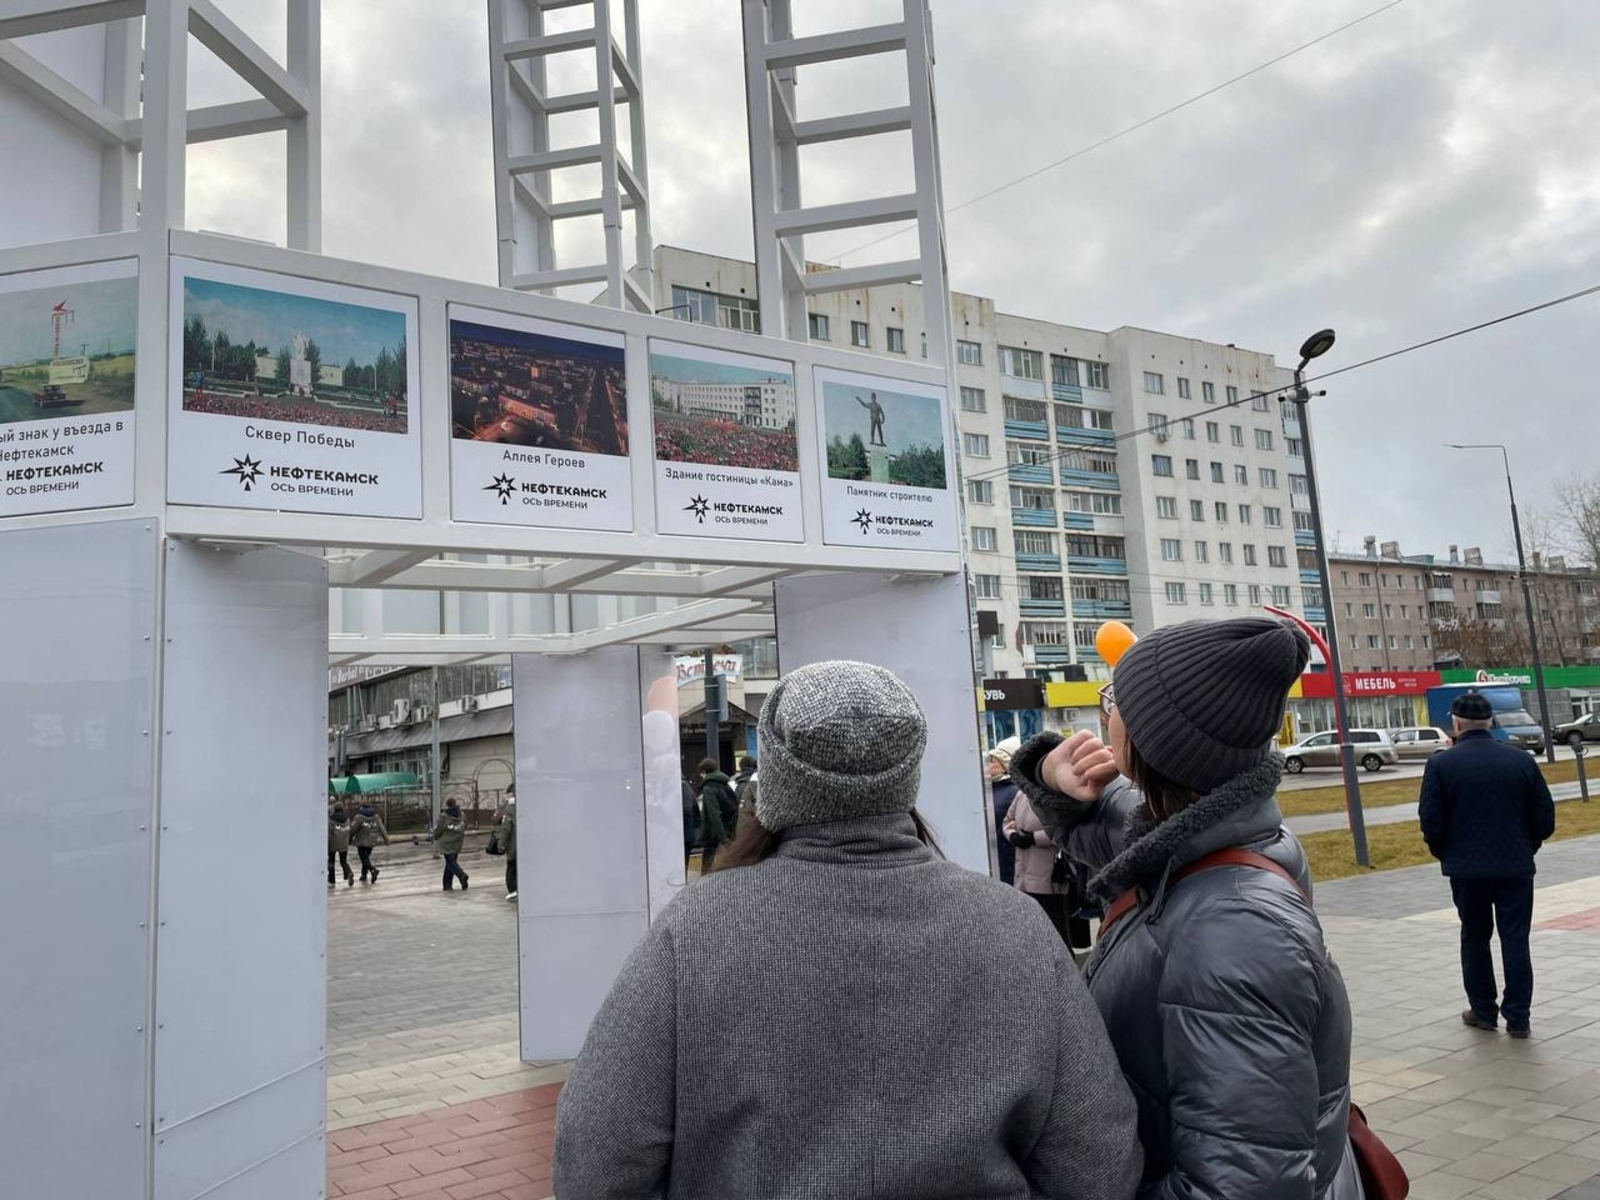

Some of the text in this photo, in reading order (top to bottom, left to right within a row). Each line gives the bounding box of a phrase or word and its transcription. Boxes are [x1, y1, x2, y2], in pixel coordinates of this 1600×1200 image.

[18, 429, 49, 441] знак
[53, 427, 60, 440] у
[64, 422, 111, 436] въезда
[115, 421, 124, 431] в
[245, 425, 355, 449] Сквер Победы
[502, 449, 586, 468] Аллея Героев
[6, 461, 104, 482] НЕФТЕКАМСК
[270, 465, 379, 485] НЕФТЕКАМСК
[665, 467, 793, 487] Здание гостиницы «Кама»
[6, 481, 80, 496] ОСЬ ВРЕМЕНИ
[270, 482, 354, 497] ОСЬ ВРЕМЕНИ
[521, 482, 608, 499] НЕФТЕКАМСК
[846, 485, 934, 503] Памятник строителю
[522, 497, 588, 509] ОСЬ ВРЕМЕНИ
[713, 502, 783, 516] НЕФТЕКАМСК
[714, 515, 769, 526] ОСЬ ВРЕМЕНИ
[875, 515, 934, 528] НЕФТЕКАМСК
[876, 527, 922, 537] ОСЬ ВРЕМЕНИ
[1355, 677, 1396, 690] МЕБЕЛЬ
